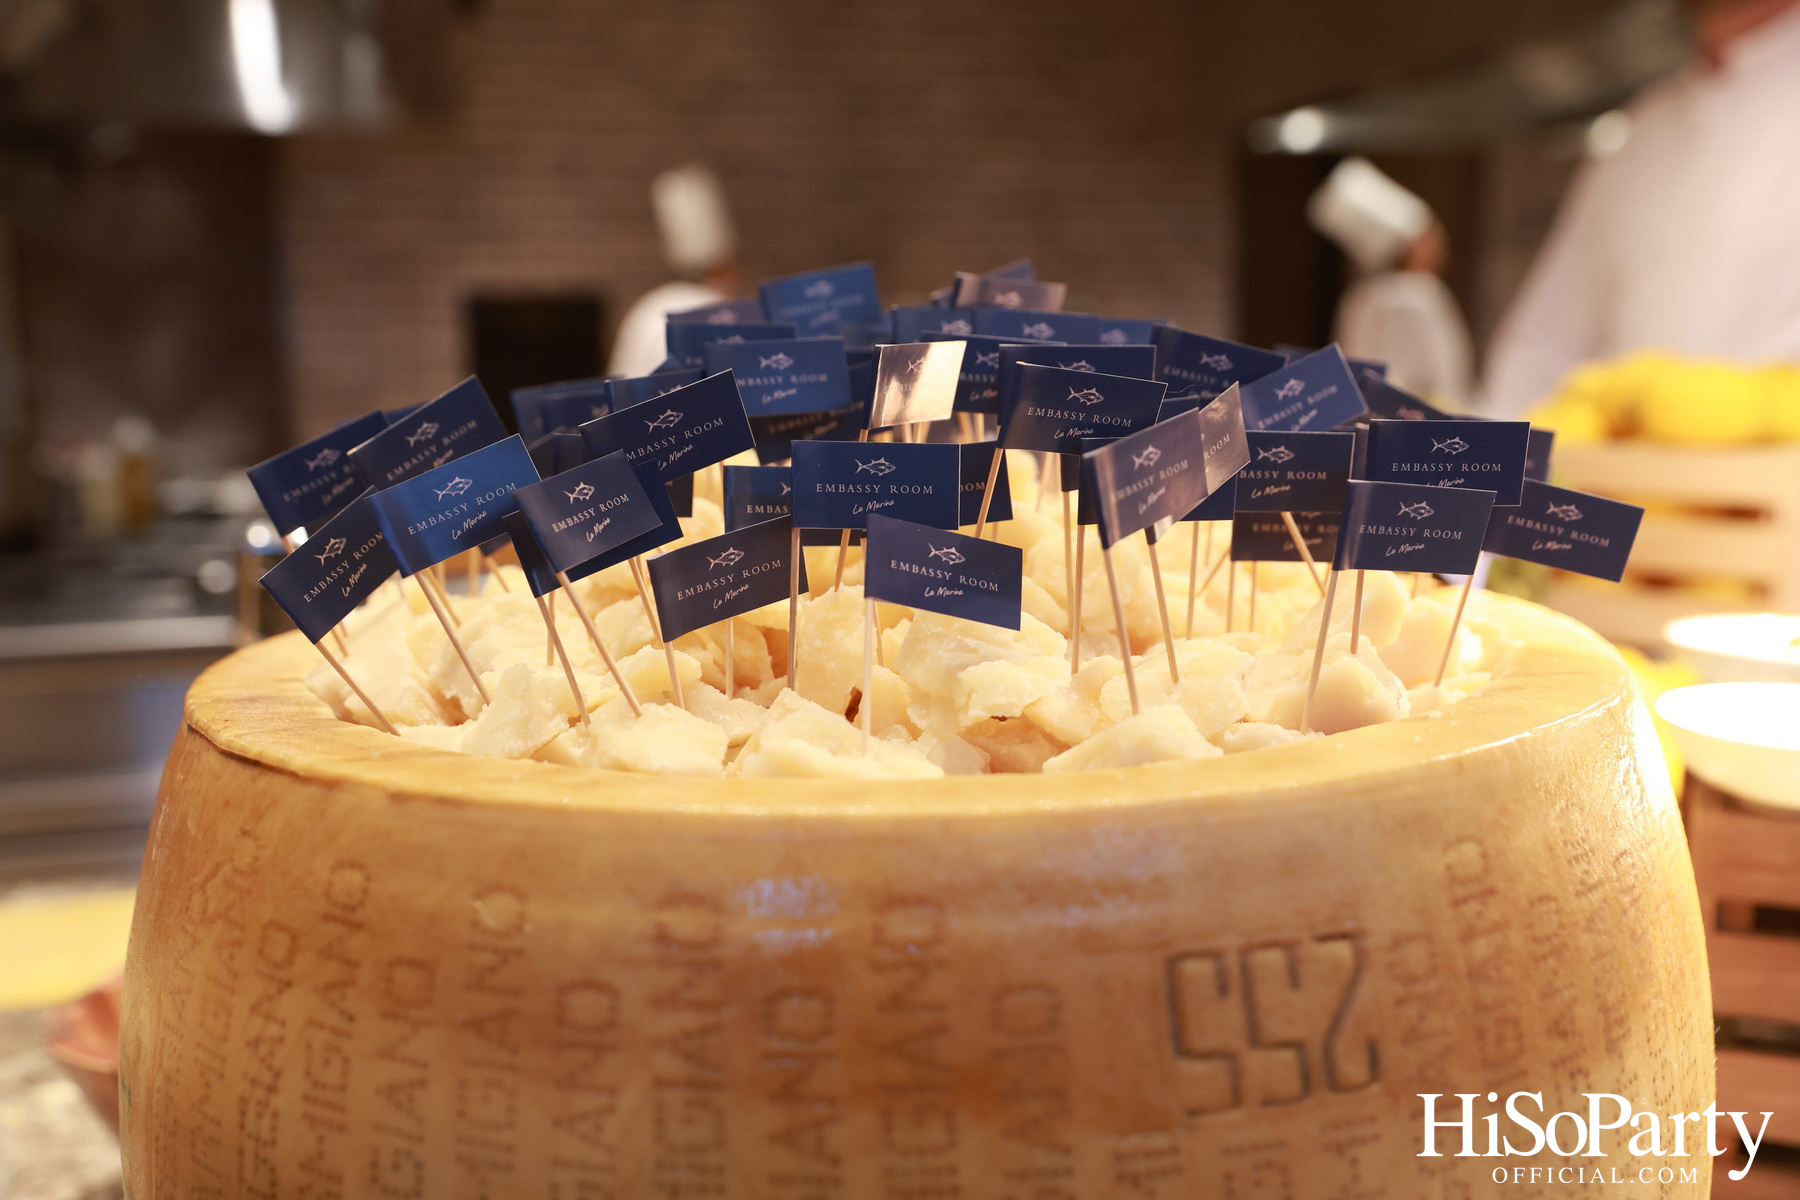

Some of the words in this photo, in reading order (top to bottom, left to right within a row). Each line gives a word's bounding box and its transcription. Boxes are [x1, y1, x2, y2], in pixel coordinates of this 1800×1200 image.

[737, 375, 783, 387] MBASSY
[790, 373, 828, 384] ROOM
[1027, 406, 1086, 421] EMBASSY
[1092, 414, 1132, 428] ROOM
[442, 419, 478, 446] ROOM
[625, 435, 676, 461] MBASSY
[683, 417, 724, 439] ROOM
[1053, 429, 1065, 439] La
[1066, 427, 1094, 438] Marina
[668, 443, 693, 464] Marina
[1203, 433, 1231, 460] ROOM
[1159, 459, 1189, 481] ROOM
[1239, 470, 1280, 479] BASSY
[1286, 470, 1327, 480] ROOM
[1391, 462, 1454, 472] EMBASSY
[1461, 462, 1502, 472] ROOM
[816, 483, 881, 493] EMBASSY
[889, 484, 934, 495] ROOM
[1250, 488, 1262, 499] La
[408, 502, 469, 535] EMBASSY
[476, 482, 518, 506] ROOM
[551, 506, 596, 533] EMBASSY
[599, 493, 630, 513] ROOM
[746, 504, 789, 514] EMBAS
[852, 503, 864, 514] La
[866, 499, 895, 512] Marina
[451, 527, 465, 541] La
[464, 509, 488, 532] Marina
[586, 528, 596, 542] La
[593, 515, 612, 537] Marina
[1359, 524, 1417, 537] EMBASSY
[1422, 528, 1463, 541] ROOM
[1507, 514, 1565, 536] EMBASSY
[1570, 529, 1610, 548] ROOM
[1386, 546, 1397, 557] La
[1397, 542, 1425, 554] Marina
[303, 560, 350, 603] EMBASSY
[341, 586, 351, 597] La
[348, 563, 367, 587] Marina
[677, 573, 735, 601] EMBASSY
[742, 559, 783, 578] ROOM
[890, 560, 952, 581] EMBASSY
[959, 575, 999, 592] ROOM
[713, 598, 724, 610] La
[725, 582, 750, 602] Marina
[924, 586, 936, 597] La
[936, 586, 964, 597] Marina
